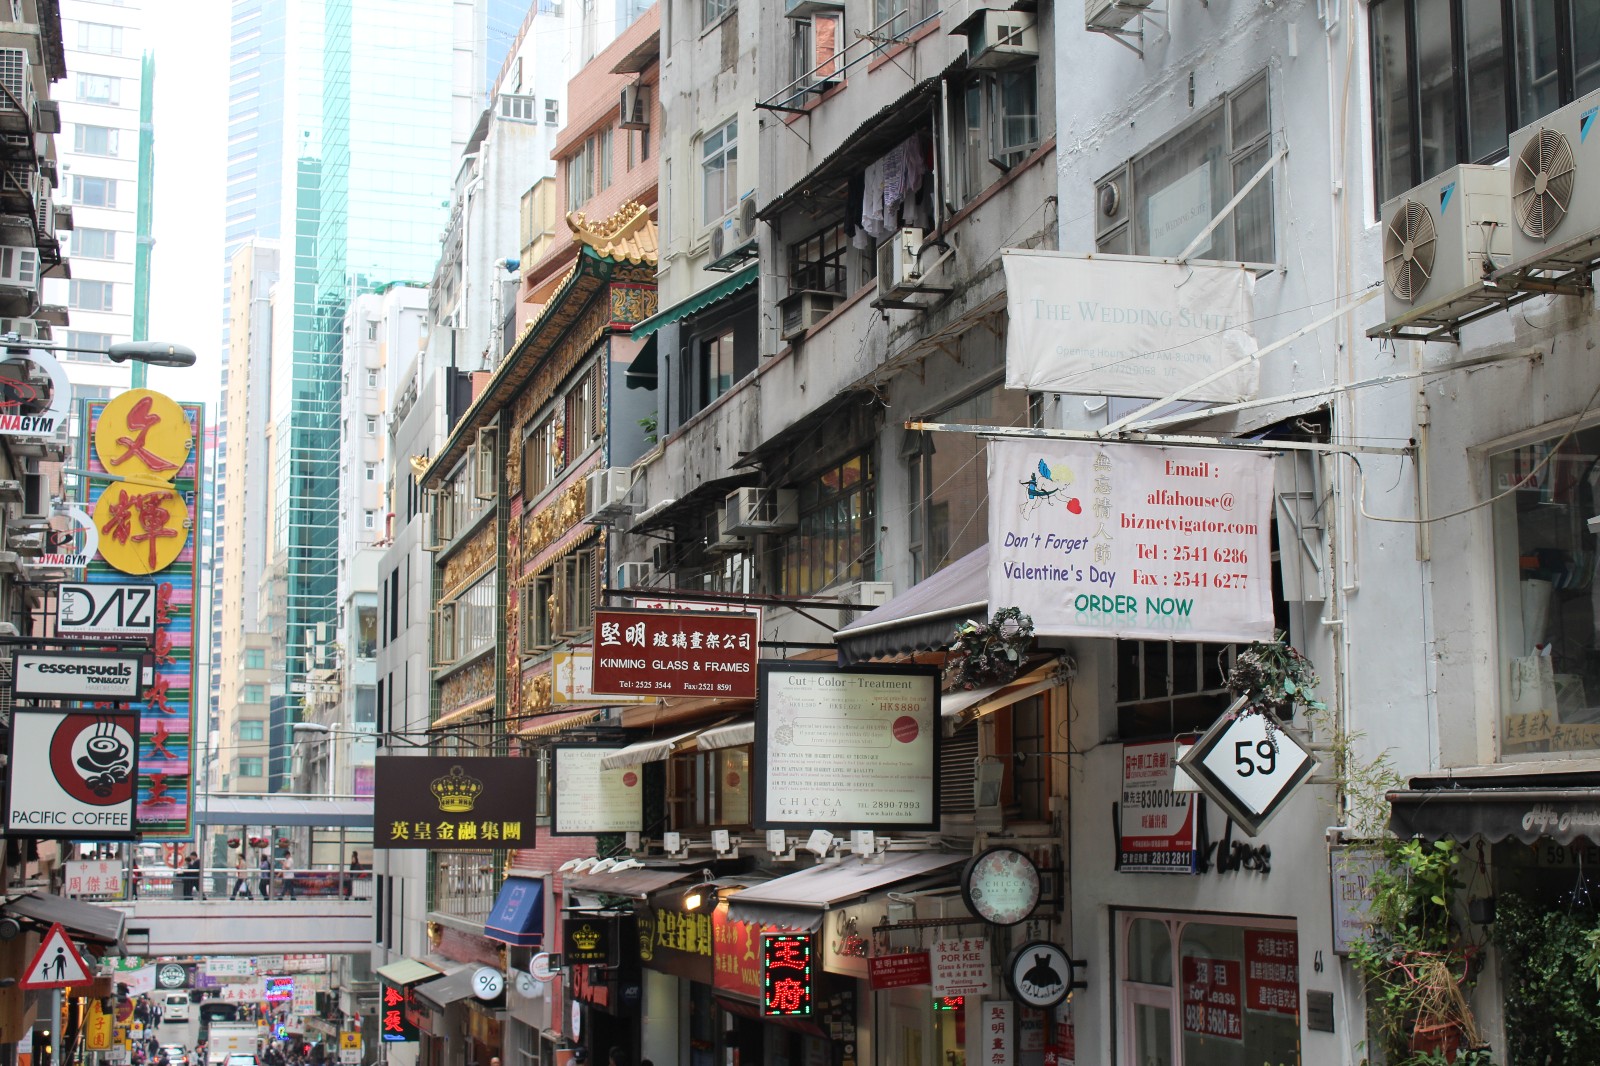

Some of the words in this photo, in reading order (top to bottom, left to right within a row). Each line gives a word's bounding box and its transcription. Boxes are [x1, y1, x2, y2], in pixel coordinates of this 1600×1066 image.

[1030, 299, 1071, 321] THE
[1078, 301, 1173, 328] WEDDING
[1178, 307, 1233, 331] SUITE
[1056, 345, 1095, 360] Opening
[0, 415, 54, 432] NAGYM
[1165, 460, 1209, 478] Email
[1093, 452, 1113, 566] 無忘情人節
[1147, 489, 1235, 512] alfahouse@
[1120, 512, 1259, 536] biznetvigator.com
[1004, 531, 1041, 549] Don't
[1045, 534, 1089, 554] Forget
[39, 553, 87, 566] DYNAGYM
[1136, 543, 1158, 560] Tel
[1173, 545, 1208, 563] 2541
[1213, 547, 1248, 565] 6286
[1003, 562, 1083, 582] Valentine's
[1089, 566, 1116, 588] Day
[1132, 568, 1158, 586] Fax
[1173, 571, 1208, 588] 2541
[1213, 573, 1248, 590] 6277
[62, 591, 75, 622] HAIR
[1074, 593, 1138, 614] ORDER
[1146, 597, 1194, 617] NOW
[600, 621, 646, 648] 堅明
[652, 630, 751, 651] 玻璃畫架公司
[38, 662, 132, 677] essensuals
[600, 658, 646, 669] KINMING
[652, 659, 689, 671] GLASS
[692, 661, 701, 671] &
[704, 661, 750, 673] FRAMES
[87, 676, 130, 685] TONI&GUY
[619, 680, 634, 688] Tel:
[635, 681, 652, 689] 2525
[716, 684, 732, 692] 8591
[788, 675, 807, 686] Cut
[817, 675, 847, 687] Color
[857, 677, 913, 690] Treatment
[879, 702, 921, 712] HK$880
[1235, 740, 1276, 777] 59
[779, 797, 843, 807] CHICCA
[12, 810, 67, 825] PACIFIC
[72, 812, 129, 827] COFFEE
[390, 820, 522, 841] 英皇金融集團
[1152, 851, 1170, 864] 2813
[1171, 851, 1190, 865] 2811
[985, 880, 1026, 888] CHICCA
[937, 963, 955, 971] Glass
[941, 953, 961, 963] POR
[962, 952, 981, 962] KEE
[1313, 950, 1324, 973] 61
[769, 940, 806, 1010] 王府
[1197, 961, 1228, 986] 招租
[1189, 984, 1205, 1001] For
[1207, 985, 1236, 1006] Lease
